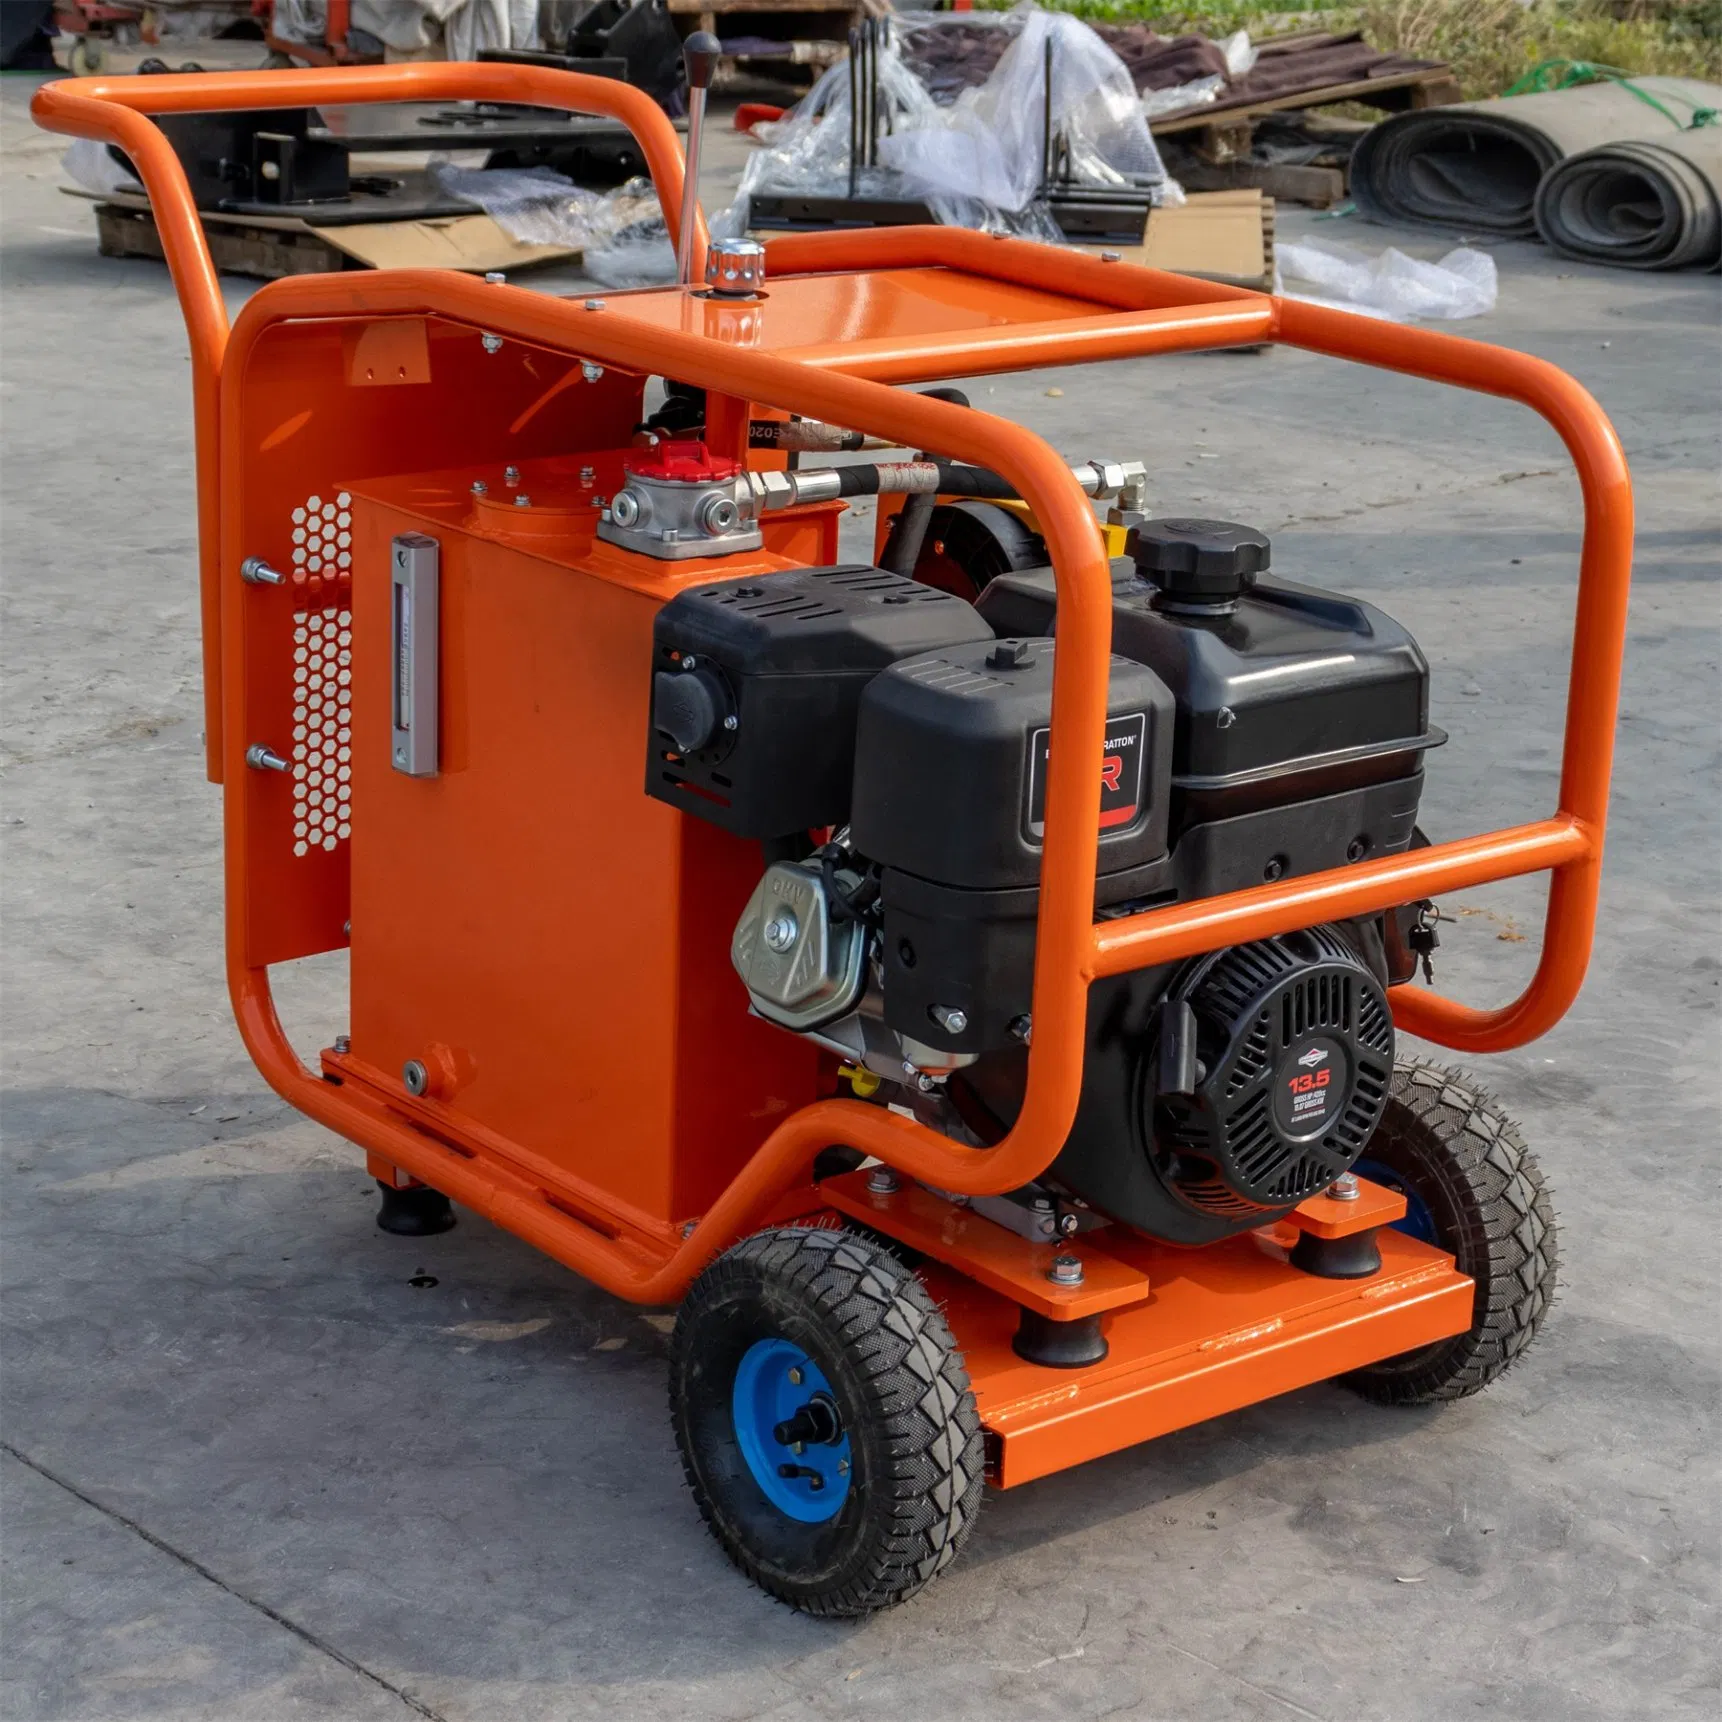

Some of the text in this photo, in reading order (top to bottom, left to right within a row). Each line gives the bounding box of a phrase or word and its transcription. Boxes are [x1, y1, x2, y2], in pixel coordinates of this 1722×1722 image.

[1103, 736, 1134, 750] RATTON
[1100, 756, 1123, 791] R
[1288, 1068, 1331, 1094] 13.5
